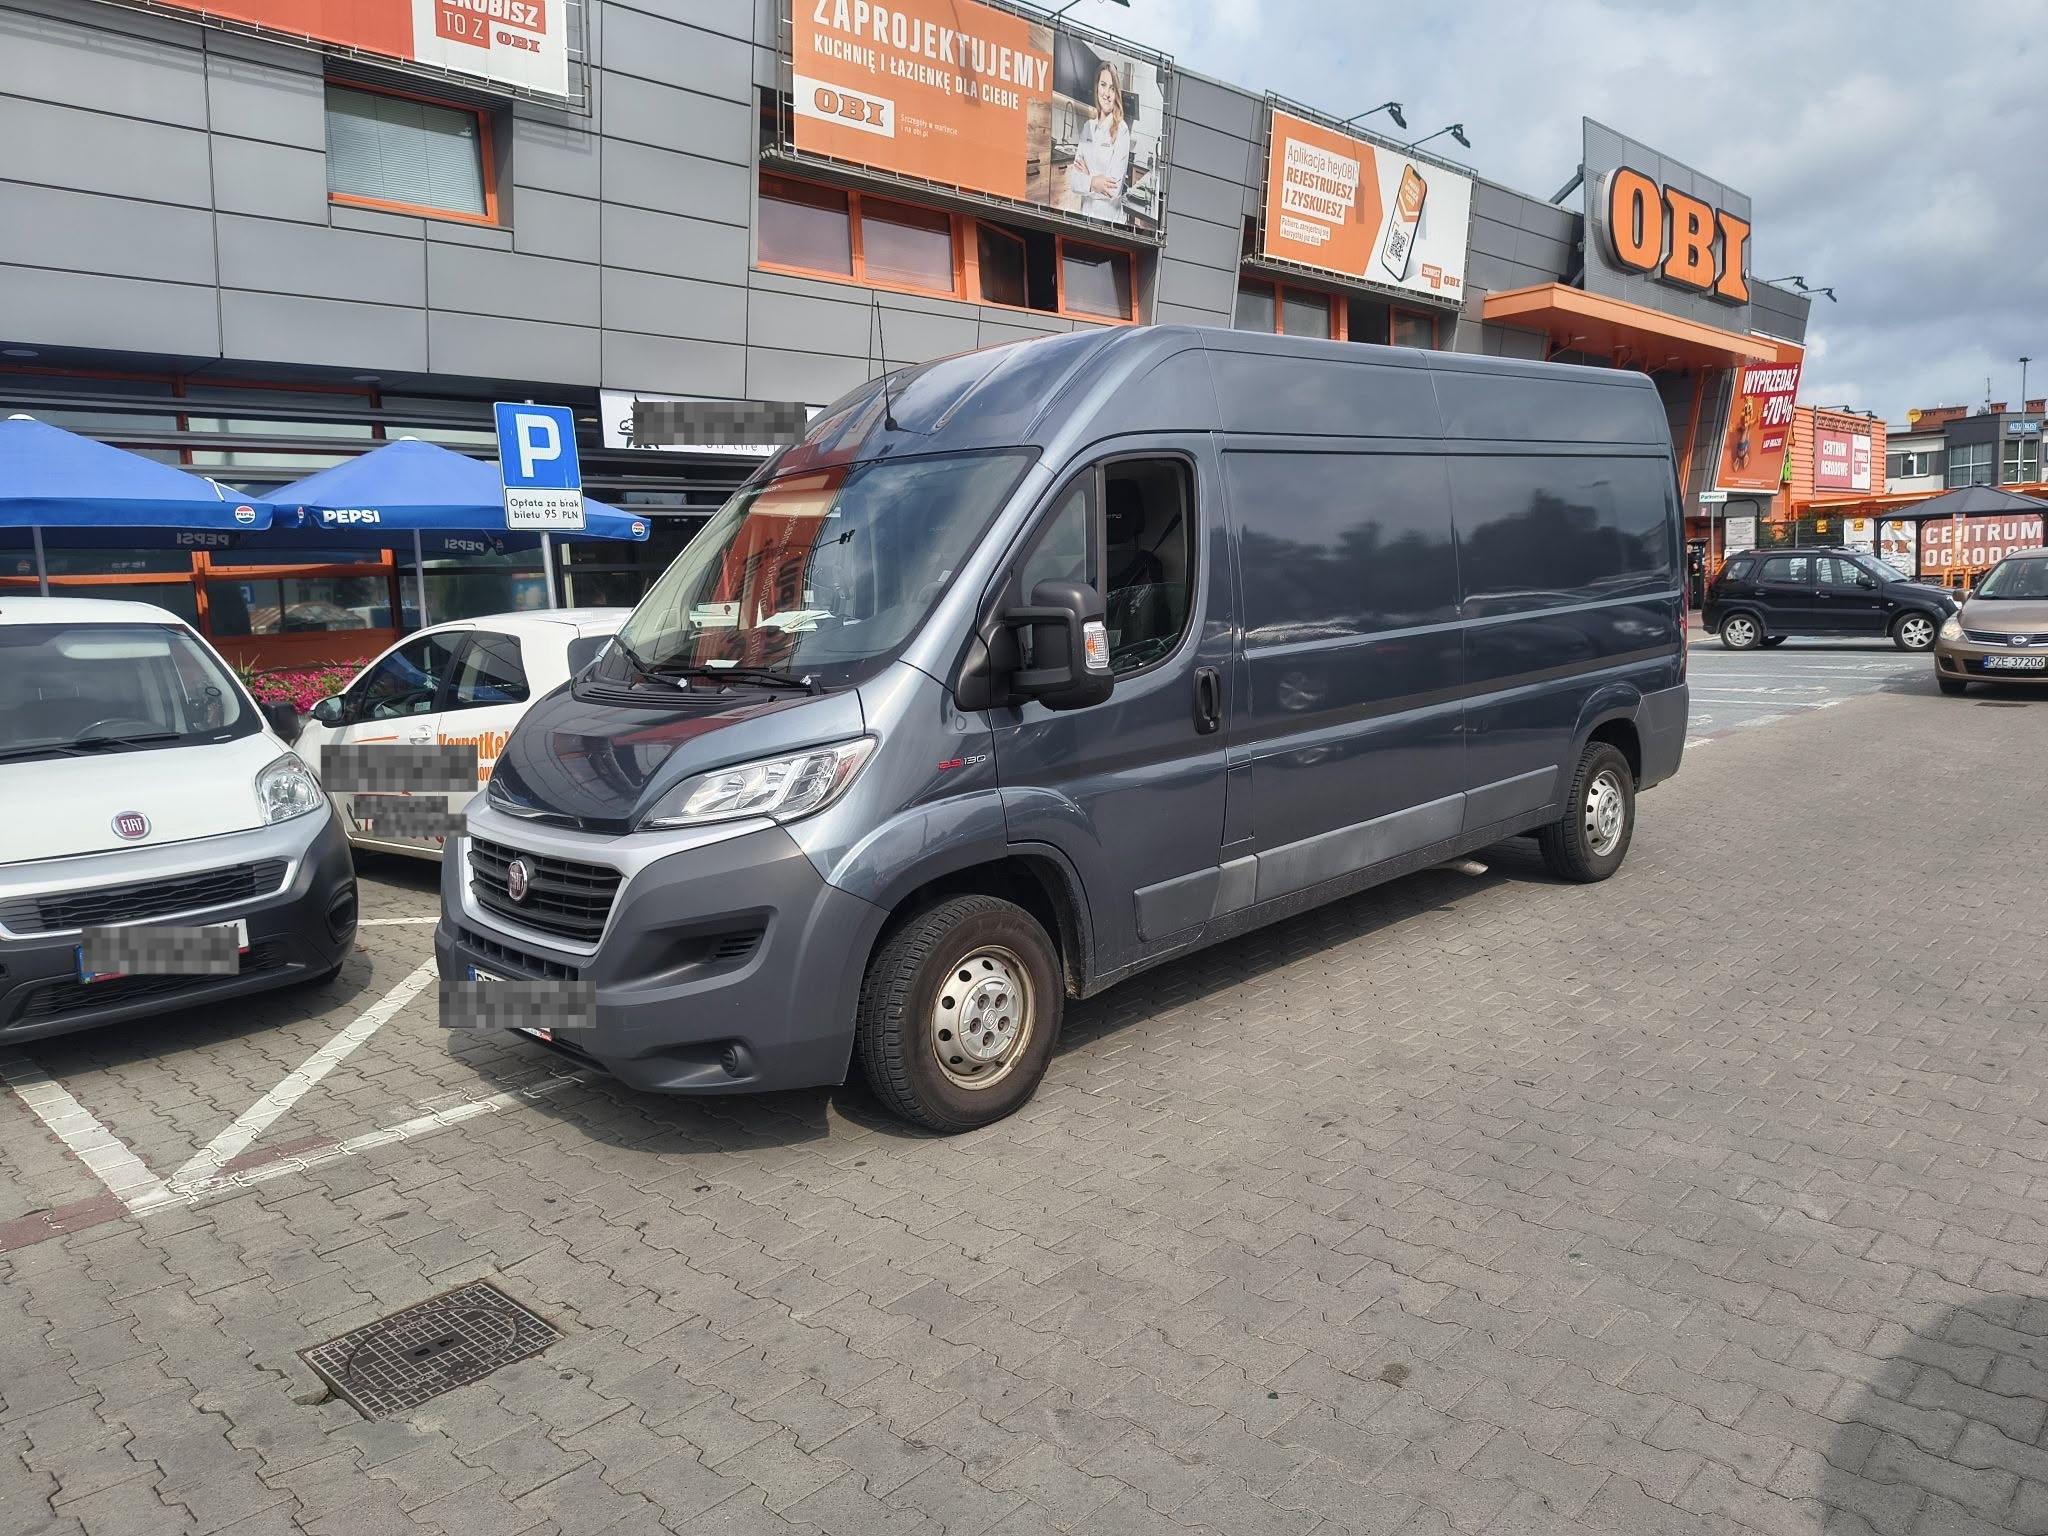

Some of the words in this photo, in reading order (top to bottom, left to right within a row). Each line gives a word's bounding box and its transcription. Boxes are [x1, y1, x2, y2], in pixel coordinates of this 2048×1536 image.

[443, 0, 538, 27] OBISZ
[443, 10, 466, 35] TO
[472, 19, 484, 39] Z
[496, 31, 540, 53] OBI
[813, 0, 1049, 92] ZAPROJEKTUJEMY
[814, 33, 876, 74] KUCHNIĘ
[880, 53, 885, 71] I
[889, 56, 951, 95] ŁAZIENKĘ
[955, 76, 978, 98] DLA
[982, 83, 1019, 110] CIEBIE
[814, 87, 884, 127] OBI
[1287, 144, 1325, 172] Aplikacja
[1286, 166, 1353, 200] REJESTRUJESZ
[1290, 190, 1343, 218] ZYSKUJESZ
[1602, 165, 1750, 306] OBI
[1742, 365, 1799, 395] WYPRZEDAŻ
[515, 413, 561, 478] P
[323, 510, 380, 523] PEPSI
[510, 498, 543, 508] Opłata
[559, 499, 579, 508] brak
[514, 510, 541, 519] biletu
[544, 510, 557, 519] 95
[562, 511, 579, 519] PLN
[1924, 545, 2042, 567] OGROD
[1990, 656, 2008, 667] RZE
[2011, 656, 2045, 667] 37206
[963, 754, 987, 765] 130
[121, 818, 143, 832] FIAT
